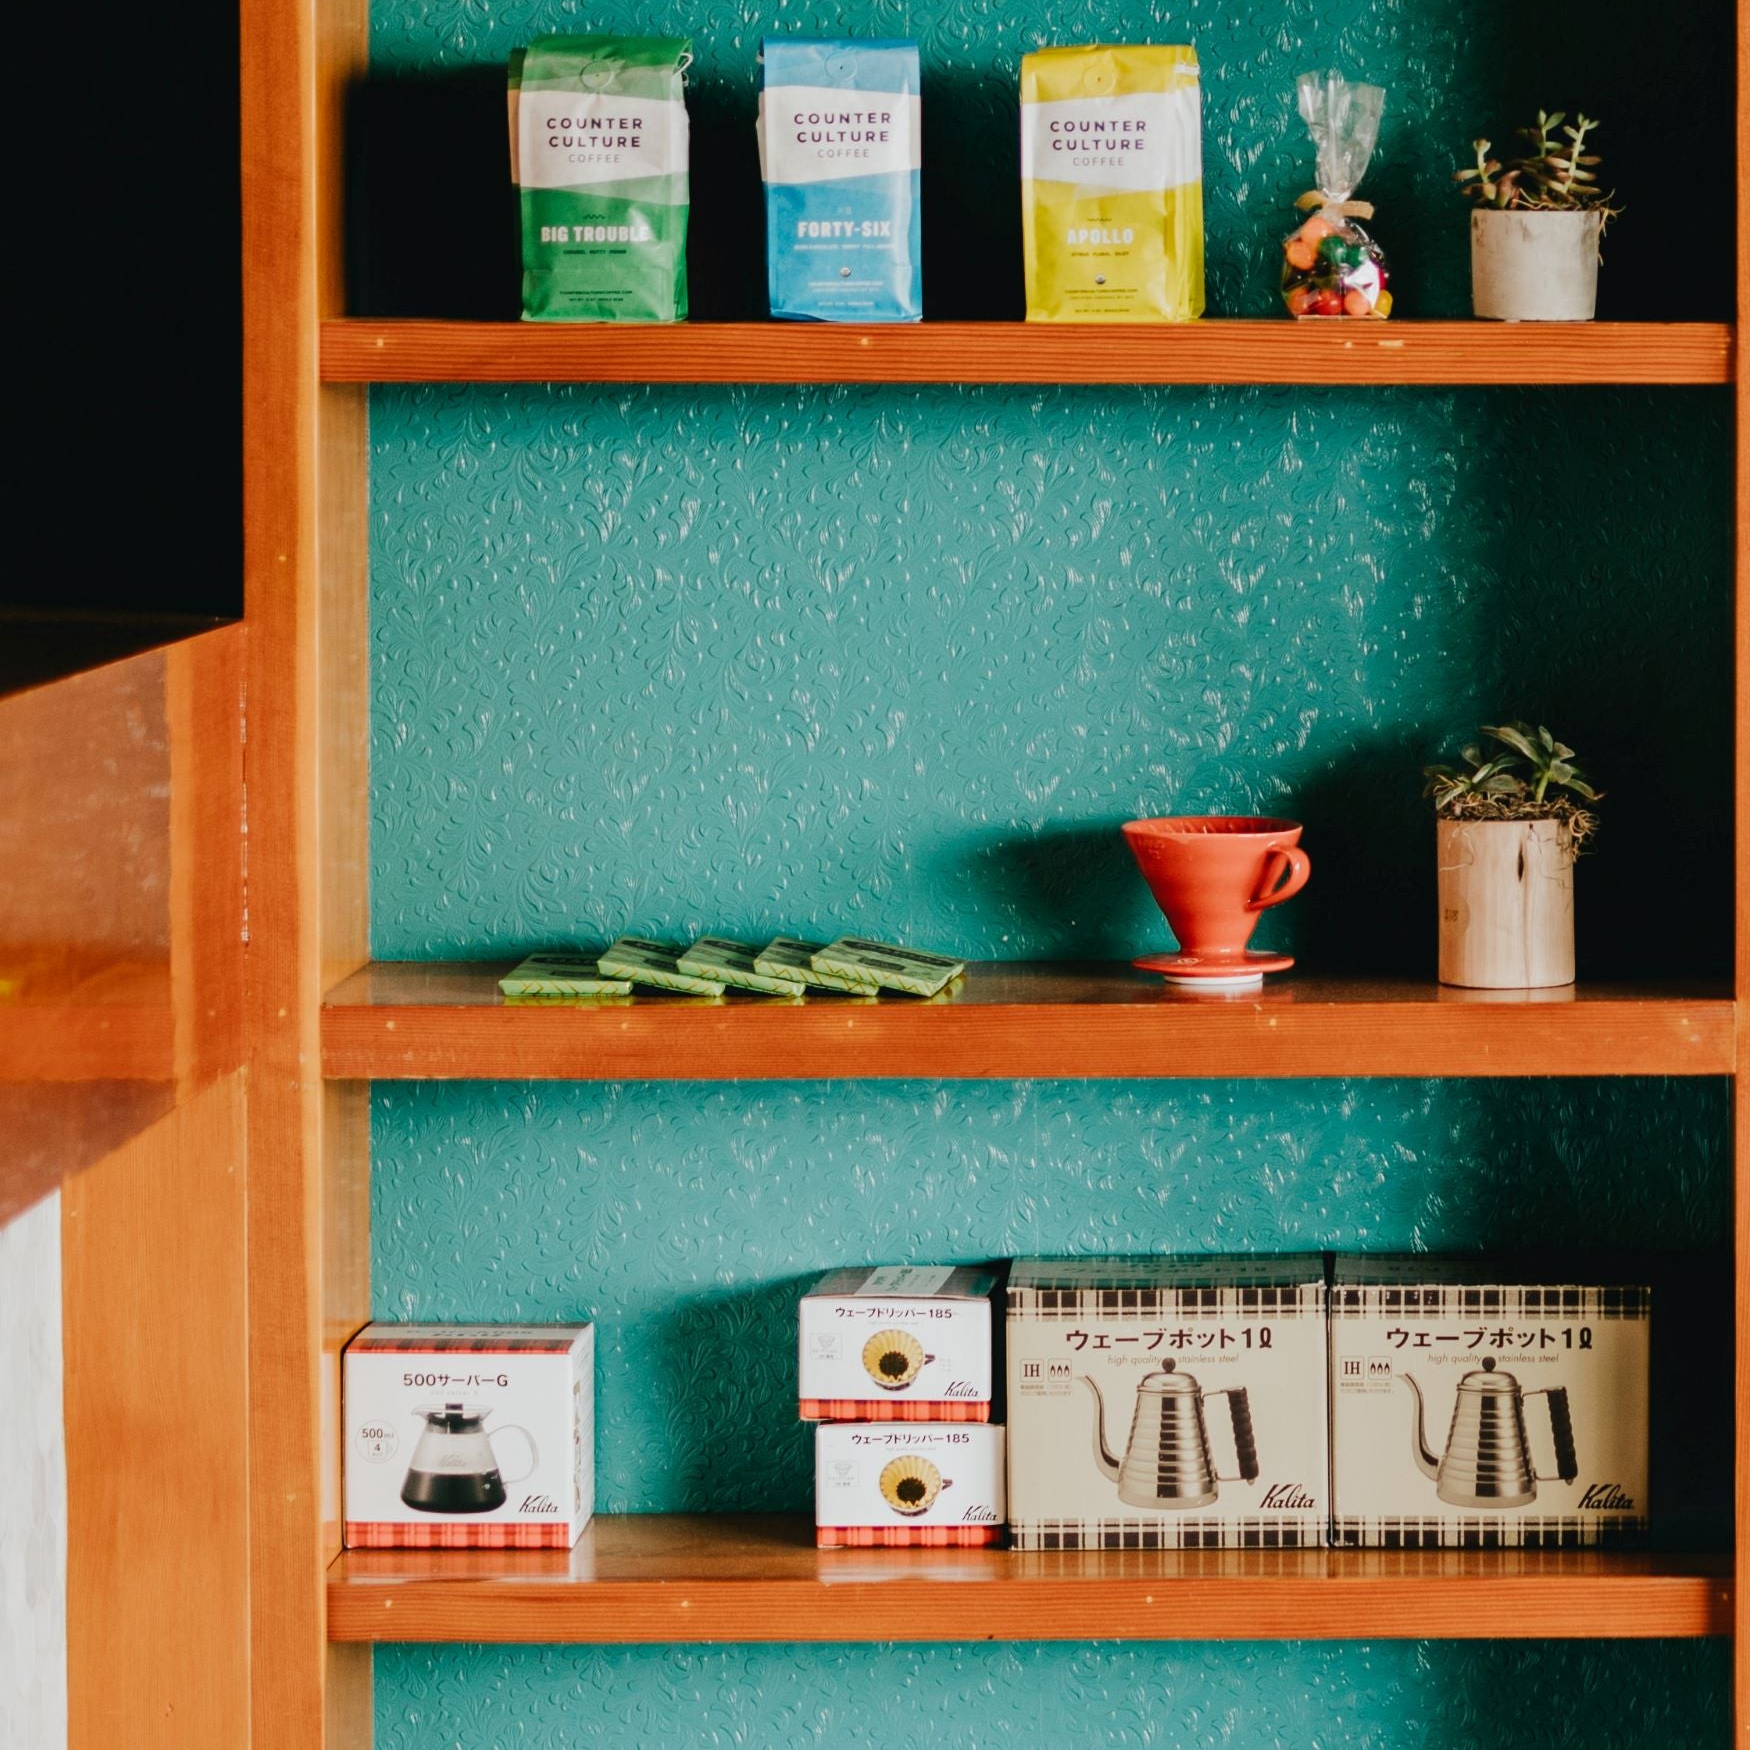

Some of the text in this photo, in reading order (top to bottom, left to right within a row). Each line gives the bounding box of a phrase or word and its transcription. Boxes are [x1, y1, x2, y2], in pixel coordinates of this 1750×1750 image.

[546, 117, 643, 130] COUNTER
[794, 112, 892, 126] COUNTER
[1050, 120, 1146, 133] COUNTER
[549, 135, 641, 148] CULTURE
[797, 130, 890, 143] CULTURE
[1053, 138, 1145, 151] CULTURE
[568, 153, 622, 163] COFFEE
[817, 148, 870, 159] COFFEE
[1072, 156, 1125, 166] COFFEE
[541, 225, 649, 243] BIG TROUBLE
[798, 220, 891, 238] FORTY-SIX
[1067, 228, 1134, 246] APOLLO
[1108, 1354, 1239, 1365] high quality stainless steel
[1428, 1353, 1560, 1364] high quality stainless steel
[1024, 1364, 1040, 1377] IH
[1344, 1361, 1361, 1375] IH
[403, 1374, 508, 1387] 500サーバーG
[944, 1381, 979, 1397] Kalita
[1259, 1484, 1316, 1509] Kalita
[1578, 1484, 1634, 1509] Kalita
[518, 1495, 559, 1513] Kalita
[962, 1505, 997, 1522] Kalita
